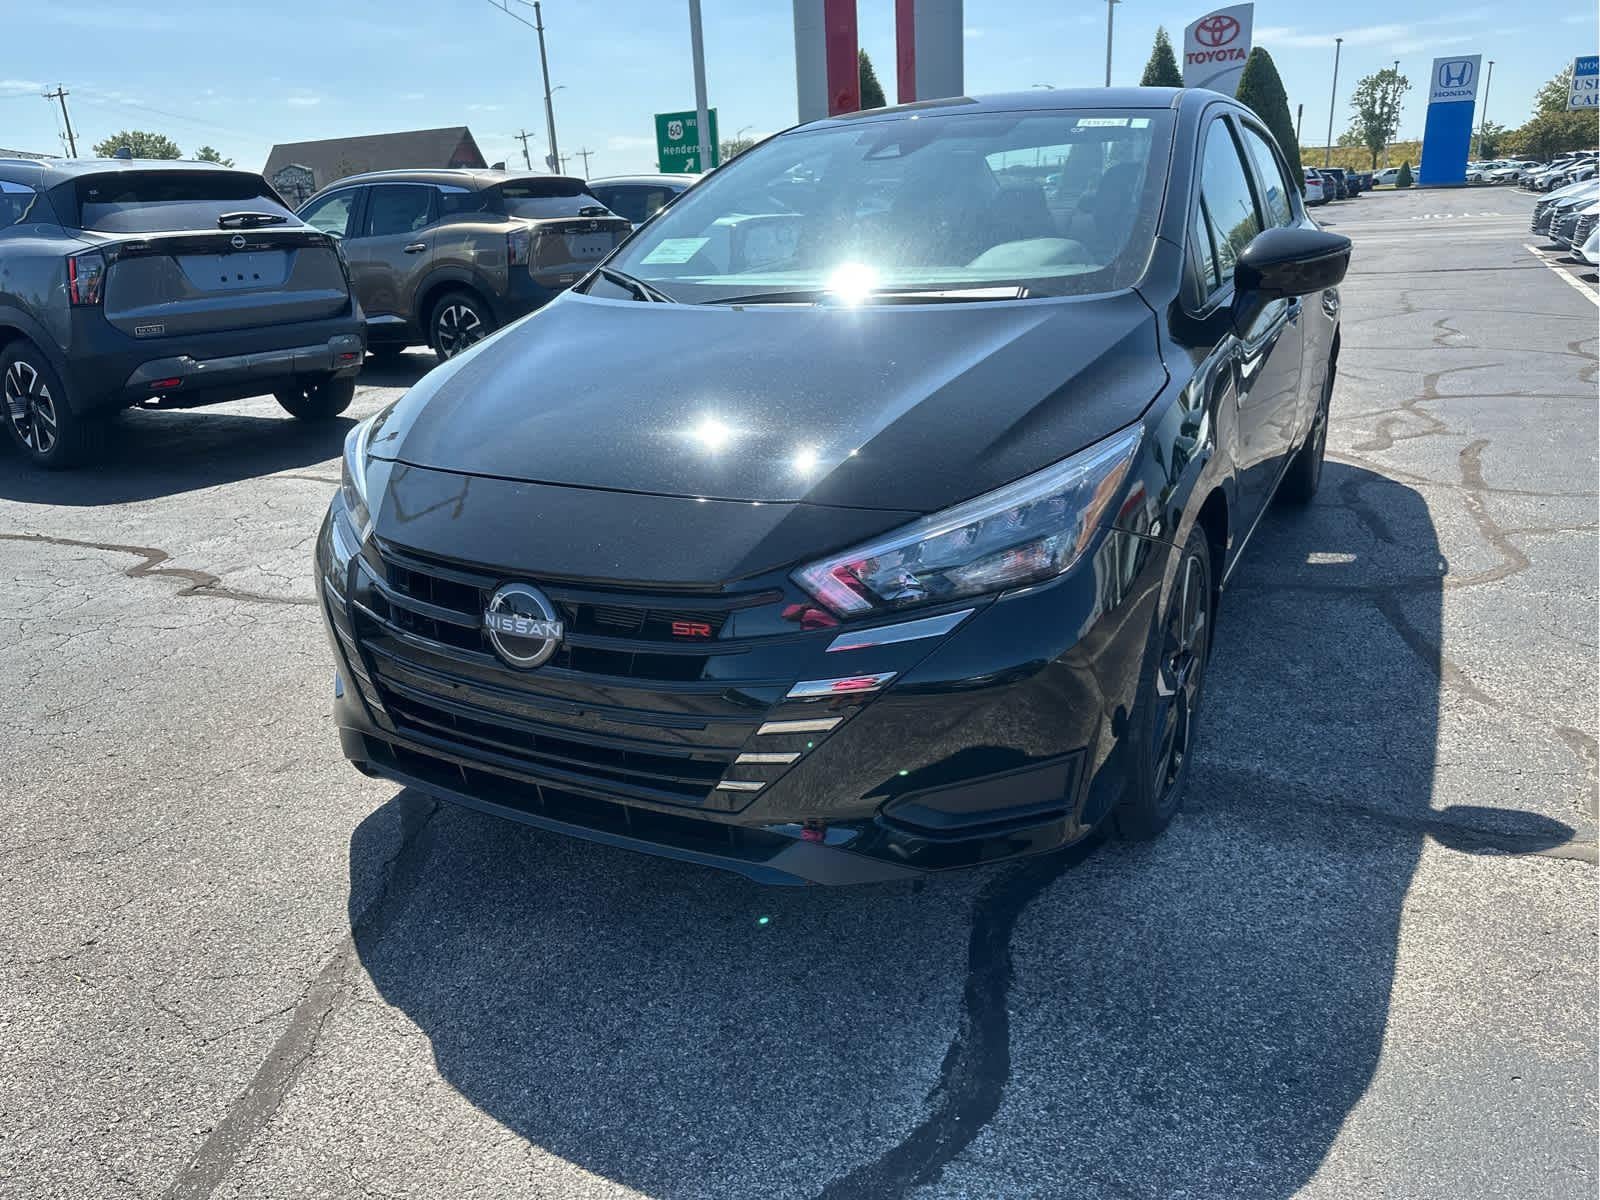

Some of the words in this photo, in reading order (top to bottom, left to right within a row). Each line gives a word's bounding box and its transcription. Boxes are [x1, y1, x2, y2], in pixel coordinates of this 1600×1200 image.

[1187, 48, 1246, 64] TOYOTA
[1433, 90, 1473, 98] HONDA
[670, 124, 682, 136] 60
[663, 145, 712, 155] Henders
[485, 613, 561, 637] NISSAN
[671, 622, 711, 637] SR
